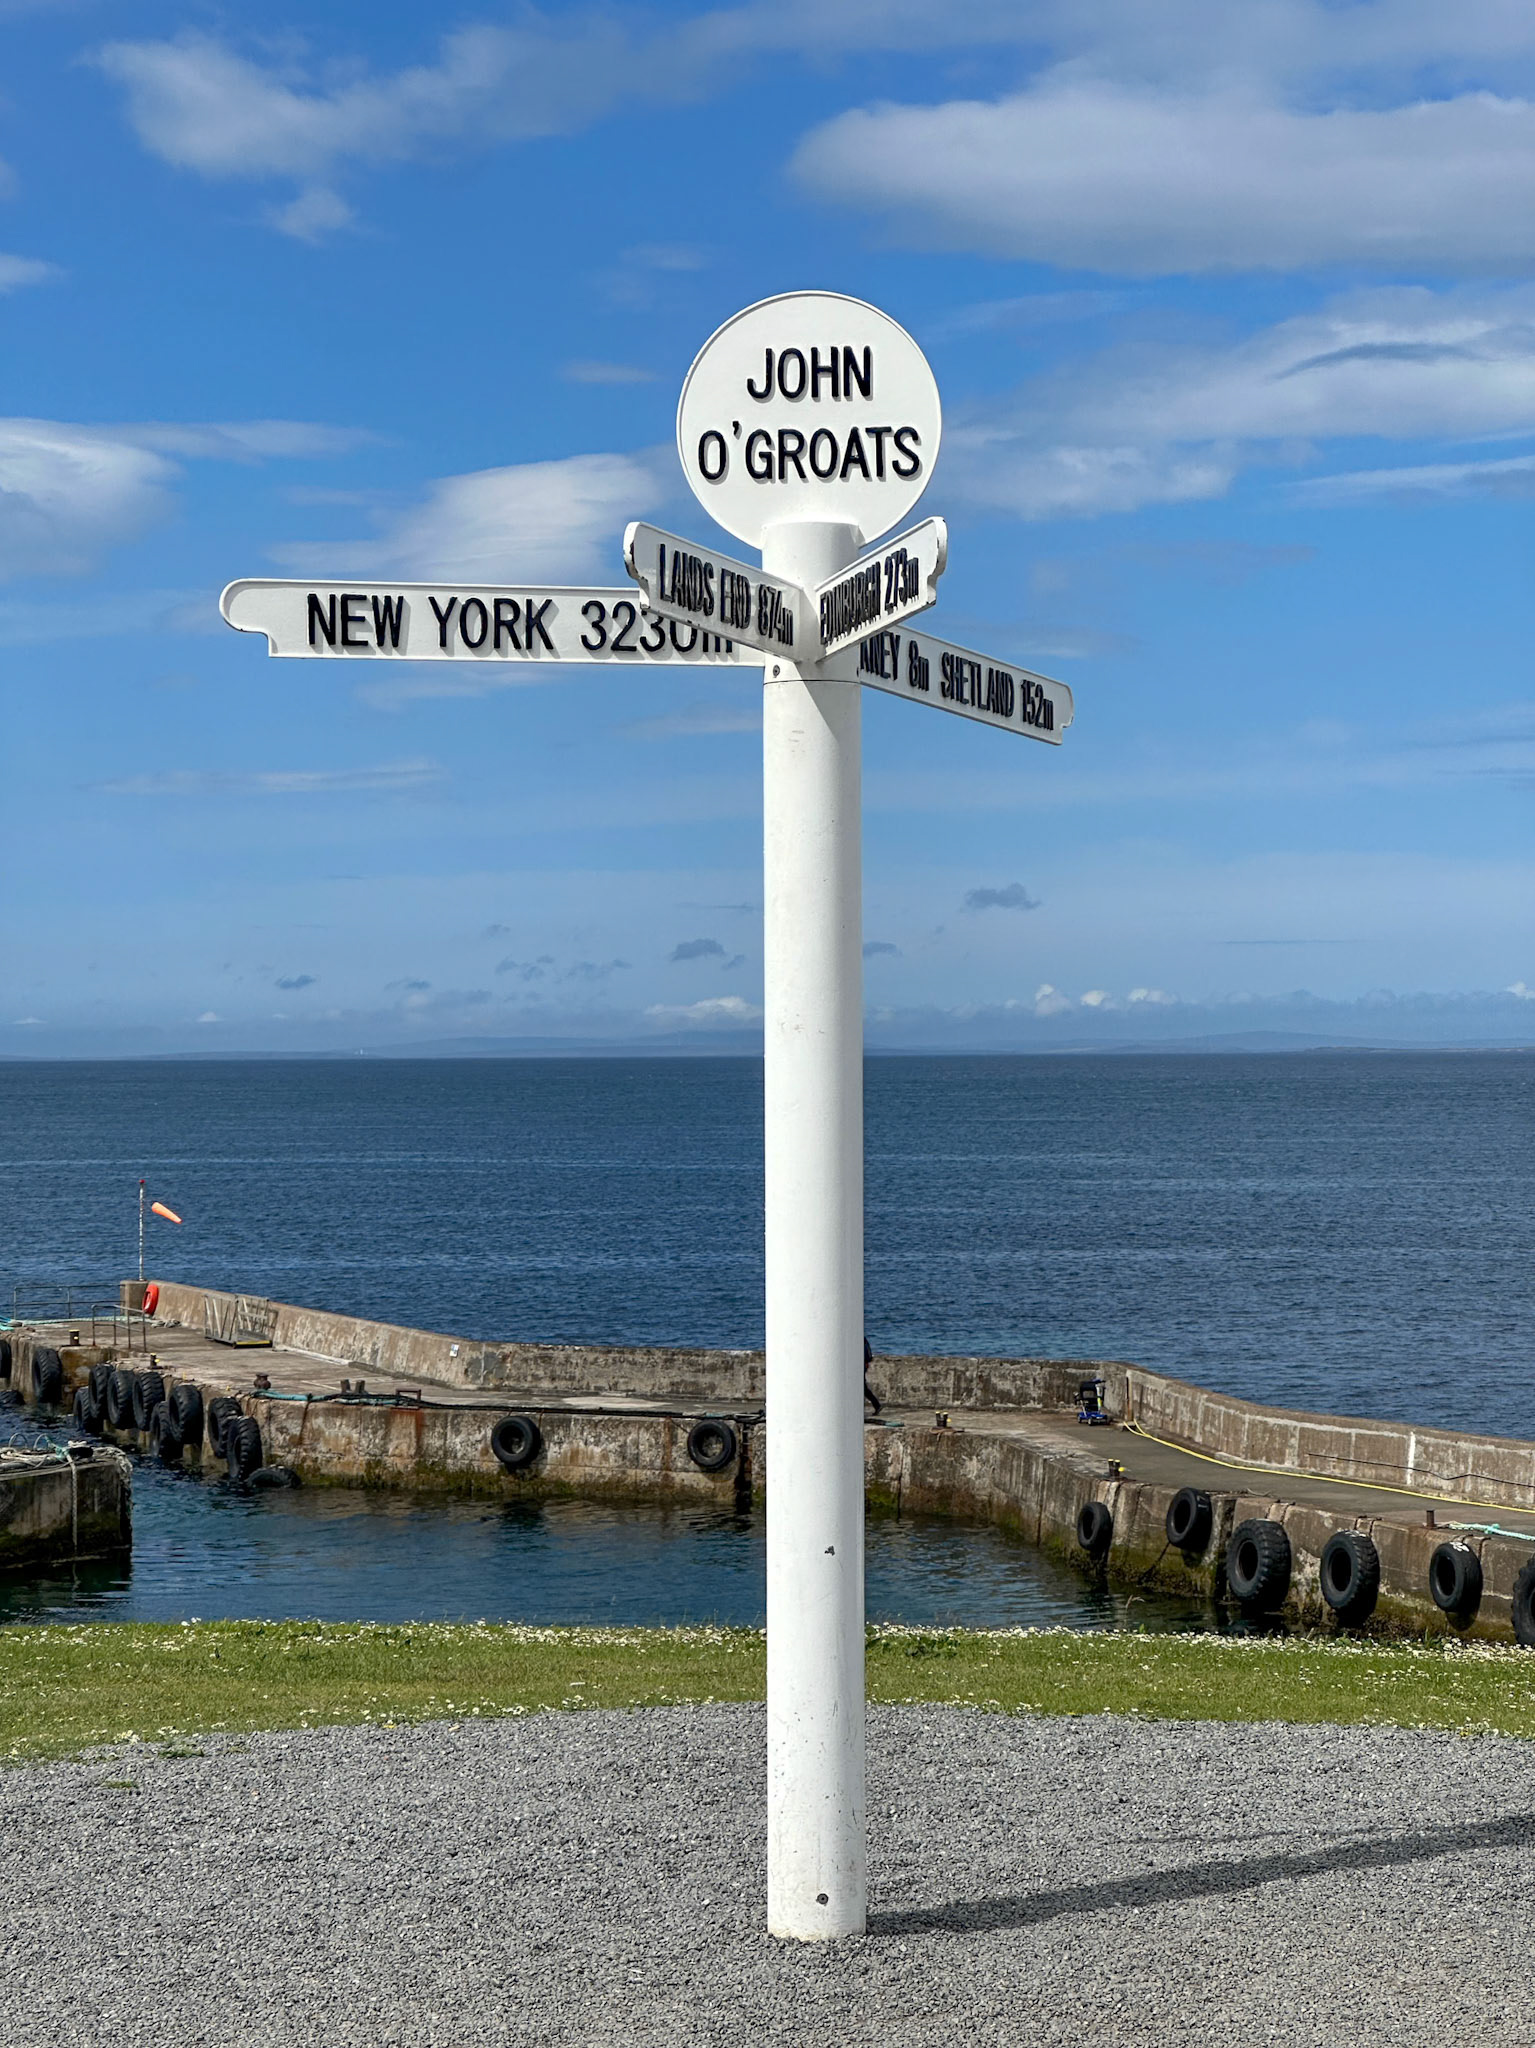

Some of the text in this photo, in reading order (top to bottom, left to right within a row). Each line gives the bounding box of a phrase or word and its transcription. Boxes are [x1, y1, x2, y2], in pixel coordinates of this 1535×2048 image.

[747, 346, 872, 399] JOHN
[698, 421, 921, 481] O'GROATS
[307, 593, 403, 648] NEW
[428, 596, 555, 650] YORK
[660, 543, 793, 646] LANDS END 874m
[820, 548, 919, 645] EDINBURGH 273m
[860, 630, 1054, 731] KNEY 8m SHETLAND 152m
